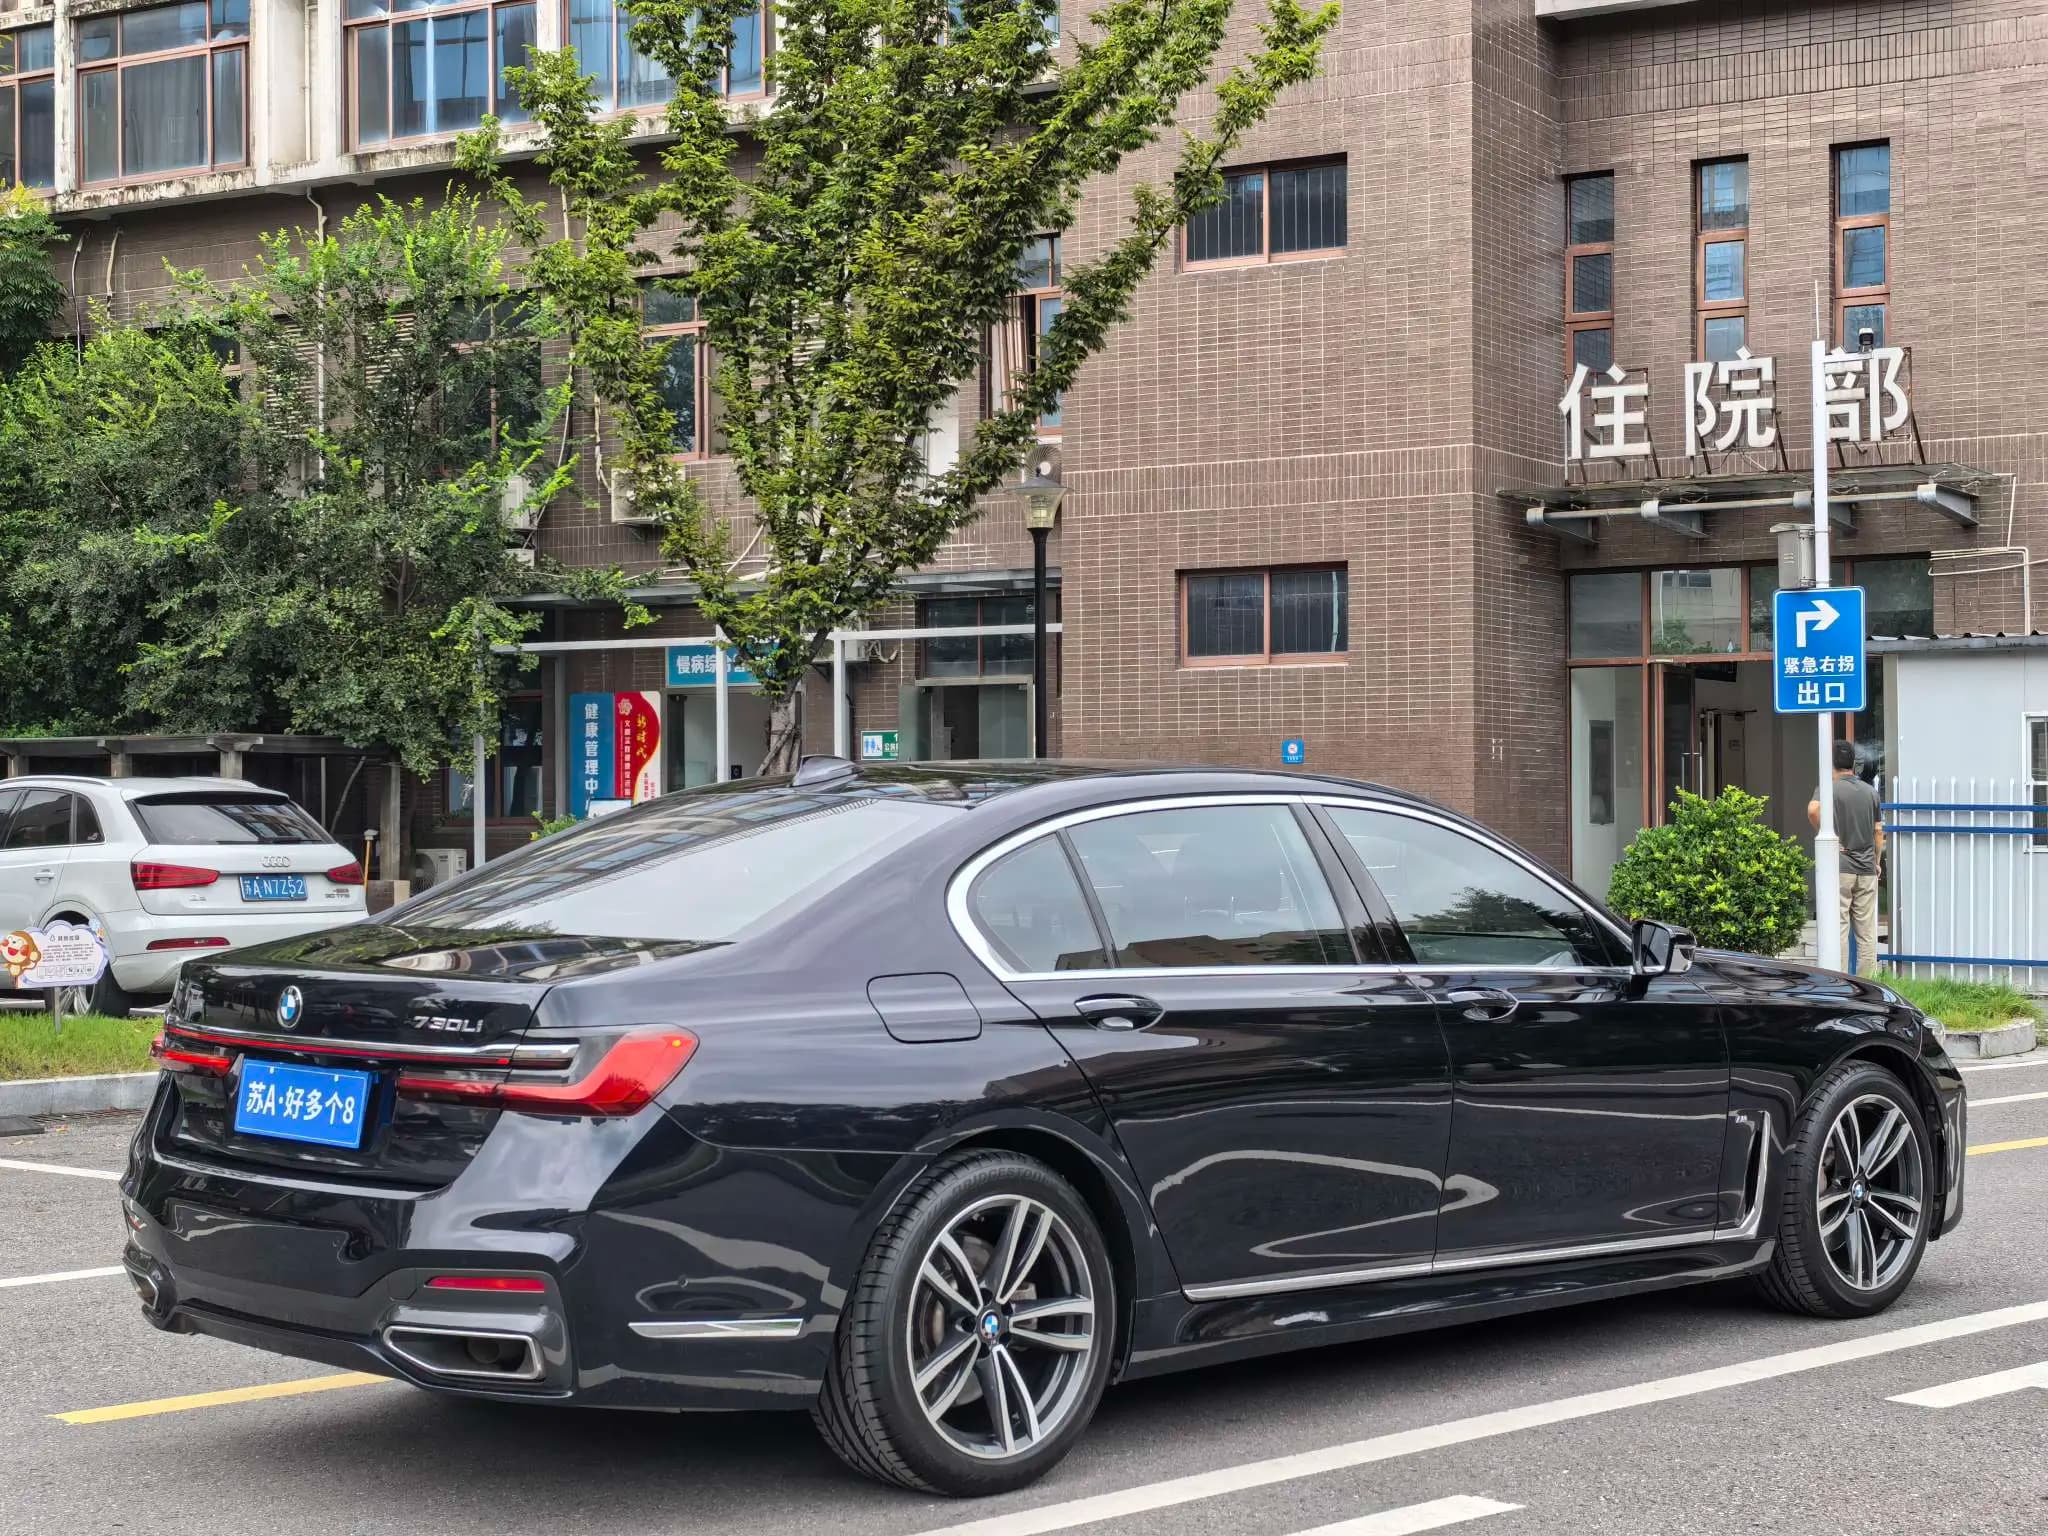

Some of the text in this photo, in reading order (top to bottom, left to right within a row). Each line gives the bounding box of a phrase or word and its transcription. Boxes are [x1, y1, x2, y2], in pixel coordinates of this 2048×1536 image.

[1558, 346, 1909, 459] 住院部
[1783, 655, 1855, 674] 紧急右拐
[1797, 680, 1845, 705] 出口
[584, 703, 599, 814] 健康管理中
[246, 1081, 355, 1125] 苏A·好多个8
